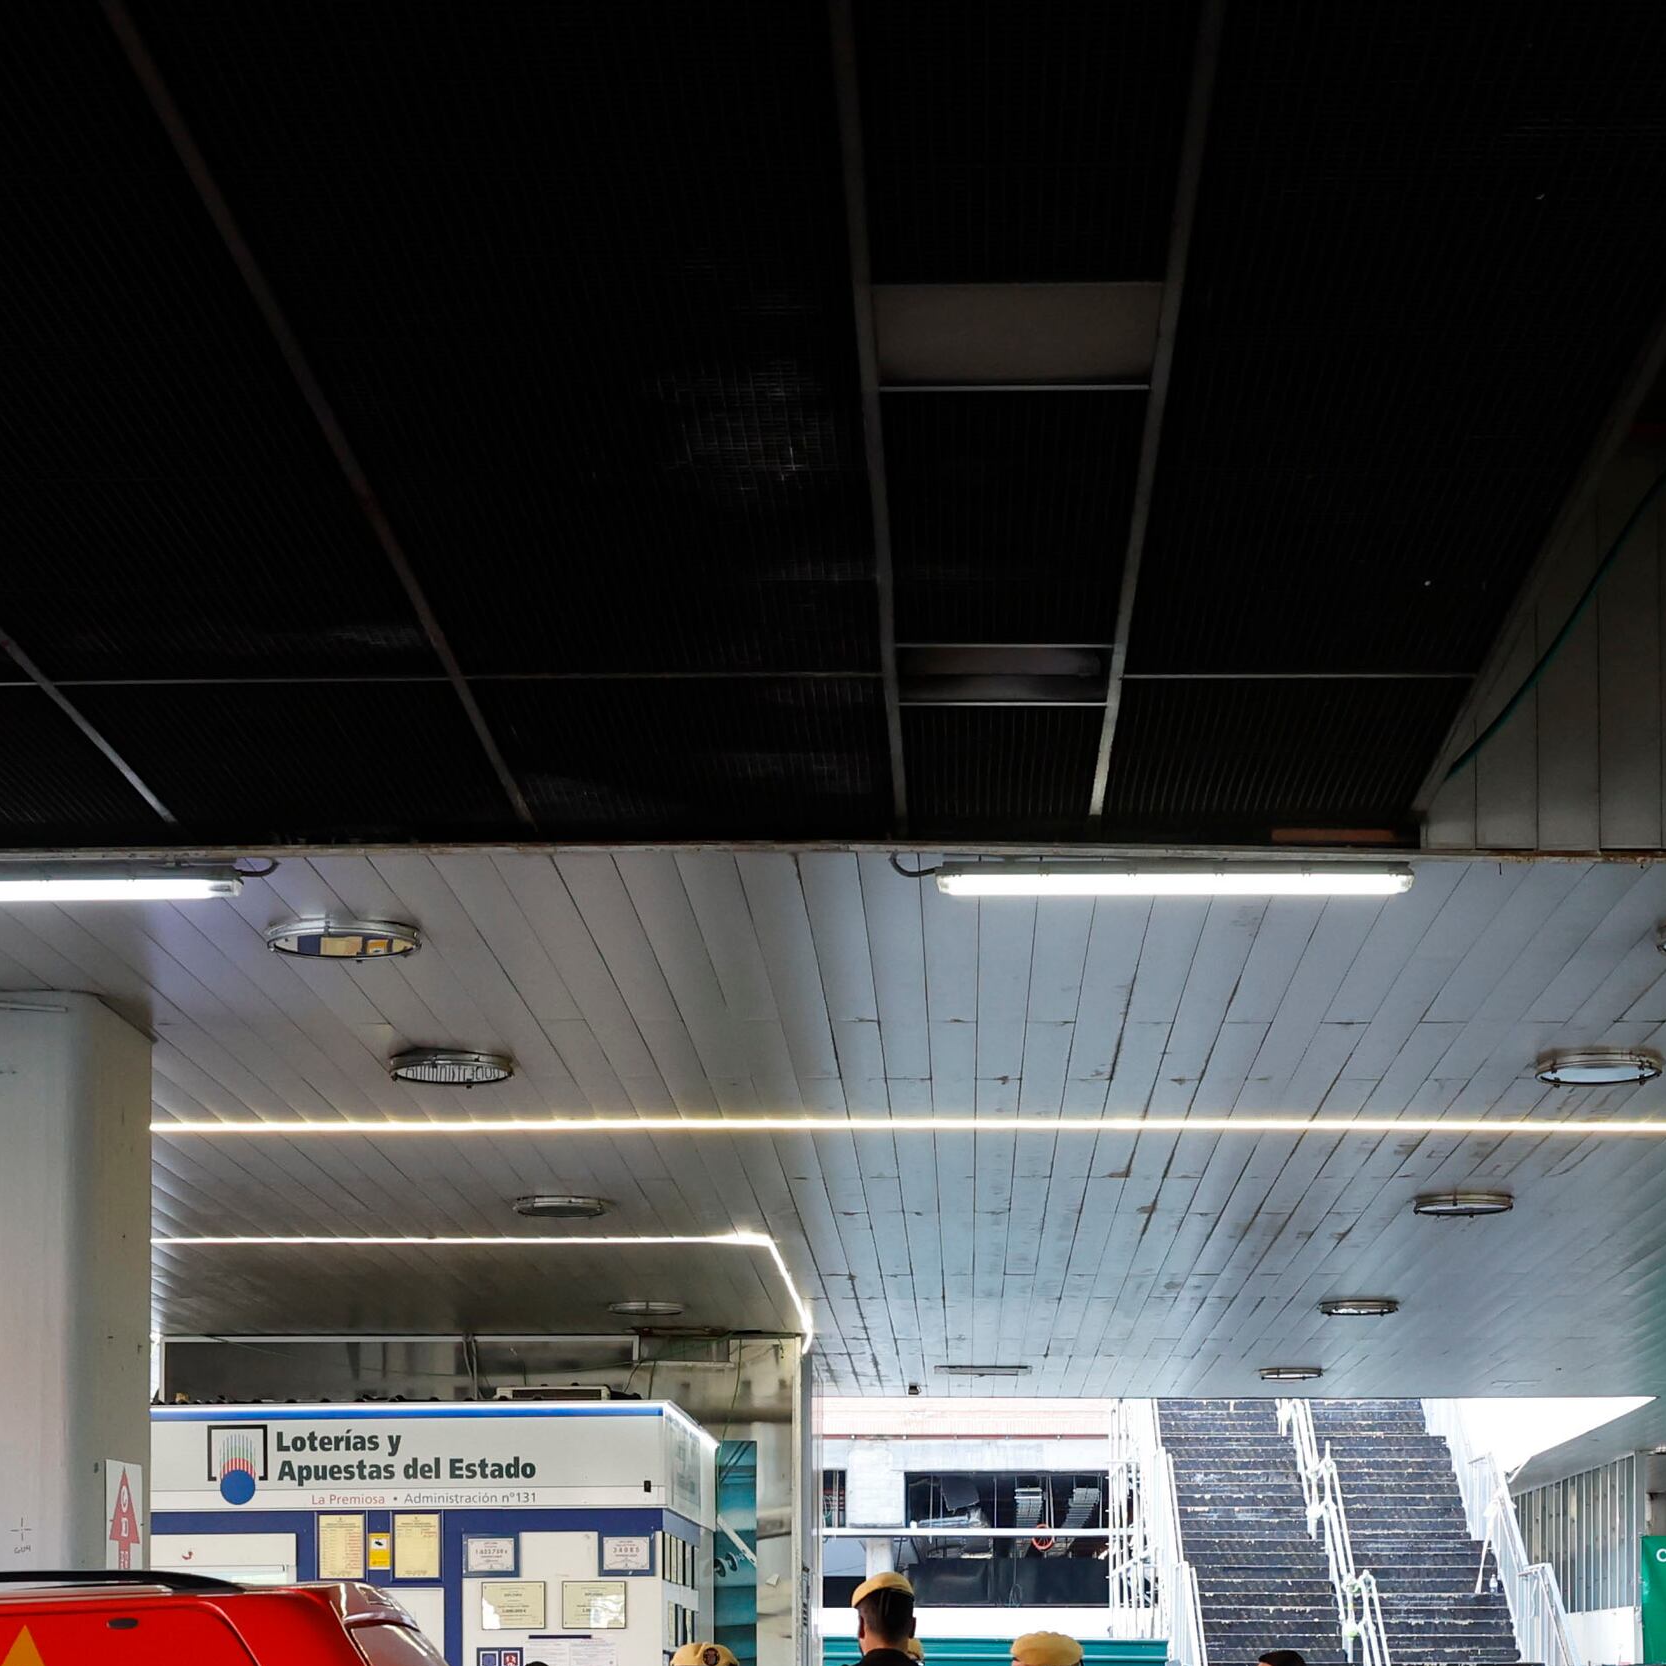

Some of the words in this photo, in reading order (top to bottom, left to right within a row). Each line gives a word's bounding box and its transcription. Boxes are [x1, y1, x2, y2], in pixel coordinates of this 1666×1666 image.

[276, 1429, 380, 1452] Loterías
[388, 1434, 402, 1457] y
[277, 1459, 396, 1487] Apuestas
[403, 1457, 441, 1480] del
[449, 1456, 537, 1480] Estado
[312, 1494, 326, 1505] La
[329, 1493, 386, 1505] Premiosa
[404, 1493, 498, 1505] Administración
